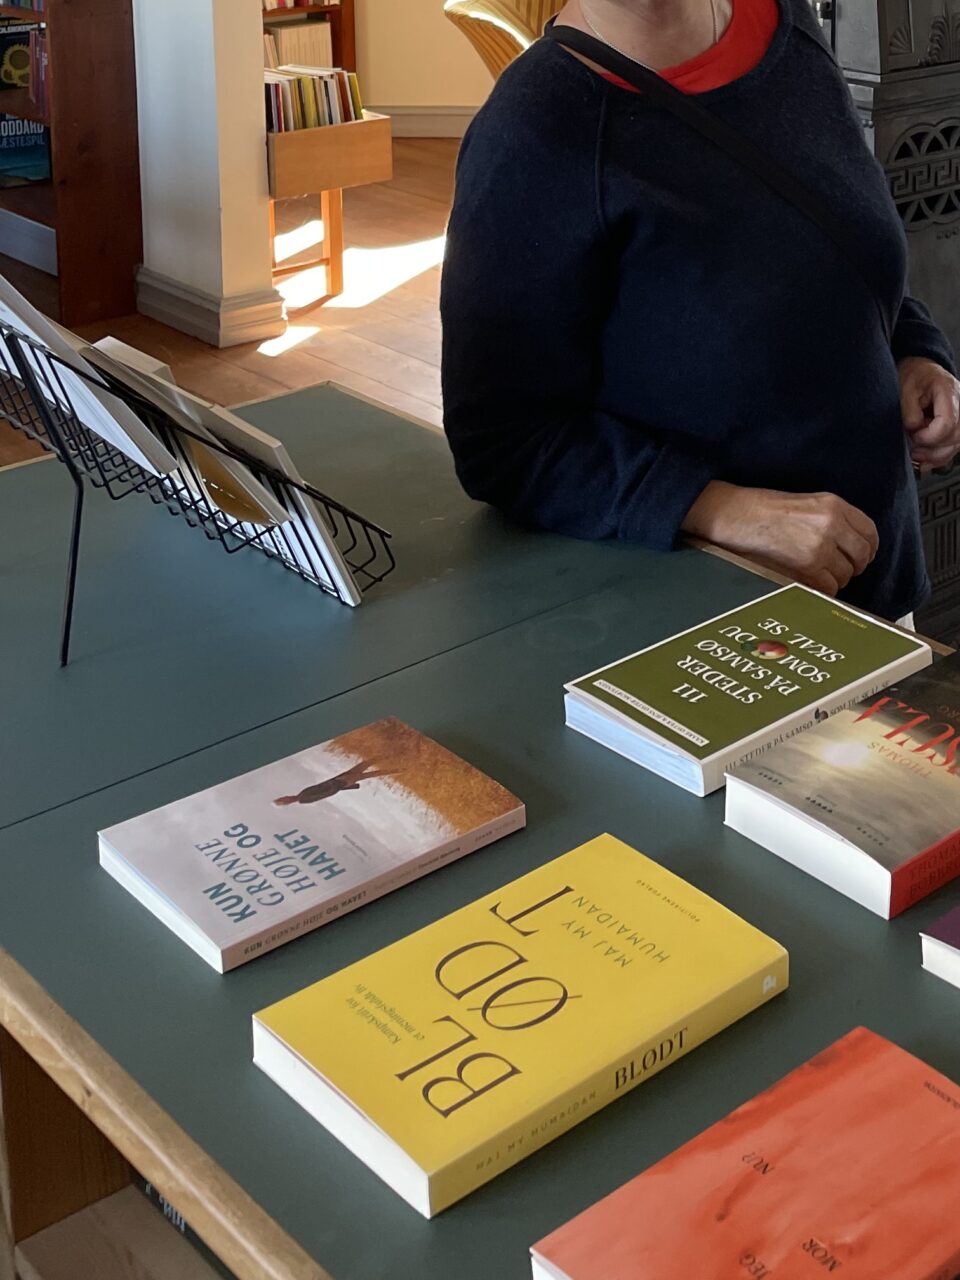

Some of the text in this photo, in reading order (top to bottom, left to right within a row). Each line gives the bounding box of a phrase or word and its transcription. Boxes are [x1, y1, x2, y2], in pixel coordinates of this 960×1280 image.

[0, 118, 44, 136] ODDARD
[0, 134, 45, 149] ÆSTESPIL
[717, 623, 831, 683] SOM DU
[756, 617, 846, 664] SKAL SE
[671, 683, 709, 703] 111
[674, 654, 763, 705] STEDER
[693, 639, 801, 697] PÅ SAMSØ
[866, 740, 932, 780] THOMAS
[223, 821, 262, 850] OG
[273, 828, 347, 881] HAVET
[194, 837, 285, 907] GRØNNE
[252, 848, 318, 894] HØJE
[201, 881, 257, 925] KUN
[243, 940, 263, 957] KUN
[340, 889, 367, 909] HAVET
[489, 885, 574, 937] T
[560, 918, 633, 969] MAJ MY
[570, 895, 671, 964] HUMAIDAN
[435, 941, 583, 1031] ØD
[394, 1015, 522, 1119] BL
[614, 1026, 689, 1091] BLØDT
[740, 1150, 775, 1177] NU?
[800, 1236, 844, 1274] MOR
